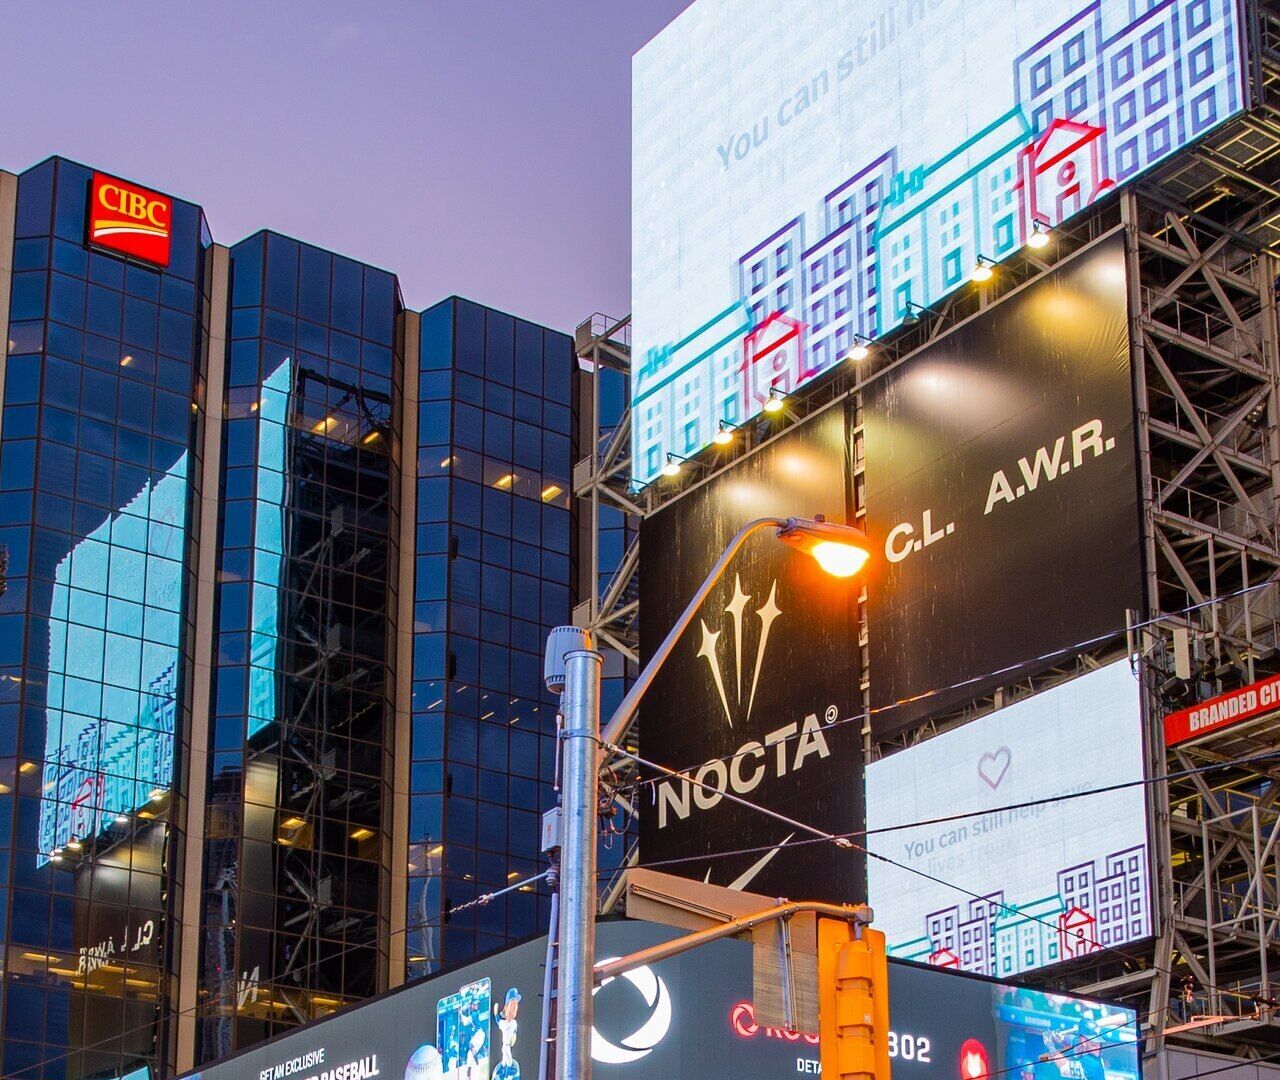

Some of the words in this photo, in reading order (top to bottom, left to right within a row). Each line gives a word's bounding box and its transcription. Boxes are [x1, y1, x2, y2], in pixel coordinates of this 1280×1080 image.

[716, 116, 768, 171] You
[777, 70, 828, 126] can
[838, 4, 895, 82] still
[99, 184, 167, 228] CIBC
[885, 507, 955, 564] C.L.
[984, 417, 1116, 516] A.W.R.
[1188, 690, 1257, 732] BRANDED
[904, 837, 934, 861] You
[939, 827, 968, 849] can
[972, 810, 1004, 837] still
[274, 1063, 284, 1080] AN
[285, 1048, 325, 1076] EXCLUSIVE
